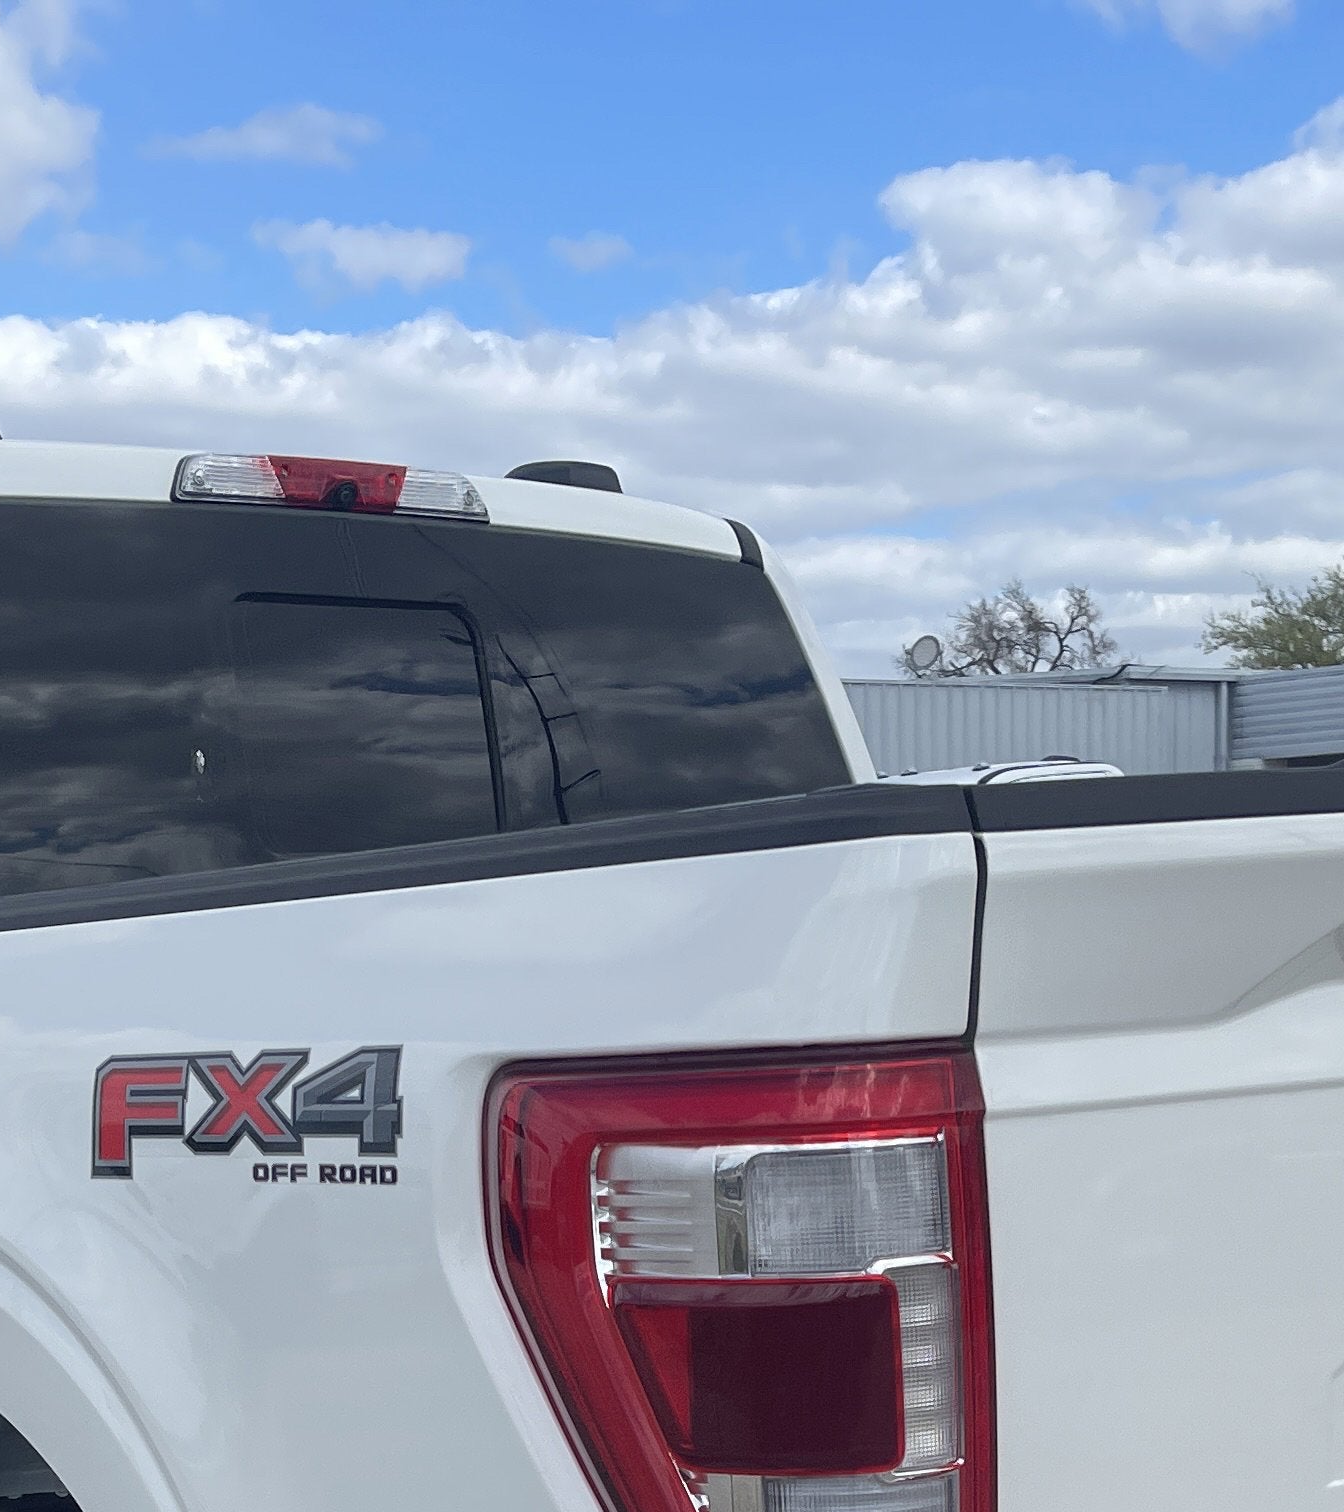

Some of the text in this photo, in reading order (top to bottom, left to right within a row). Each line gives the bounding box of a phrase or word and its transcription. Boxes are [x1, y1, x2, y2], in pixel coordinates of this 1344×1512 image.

[90, 1044, 404, 1180] FX4
[252, 1162, 399, 1185] OFF ROAD
